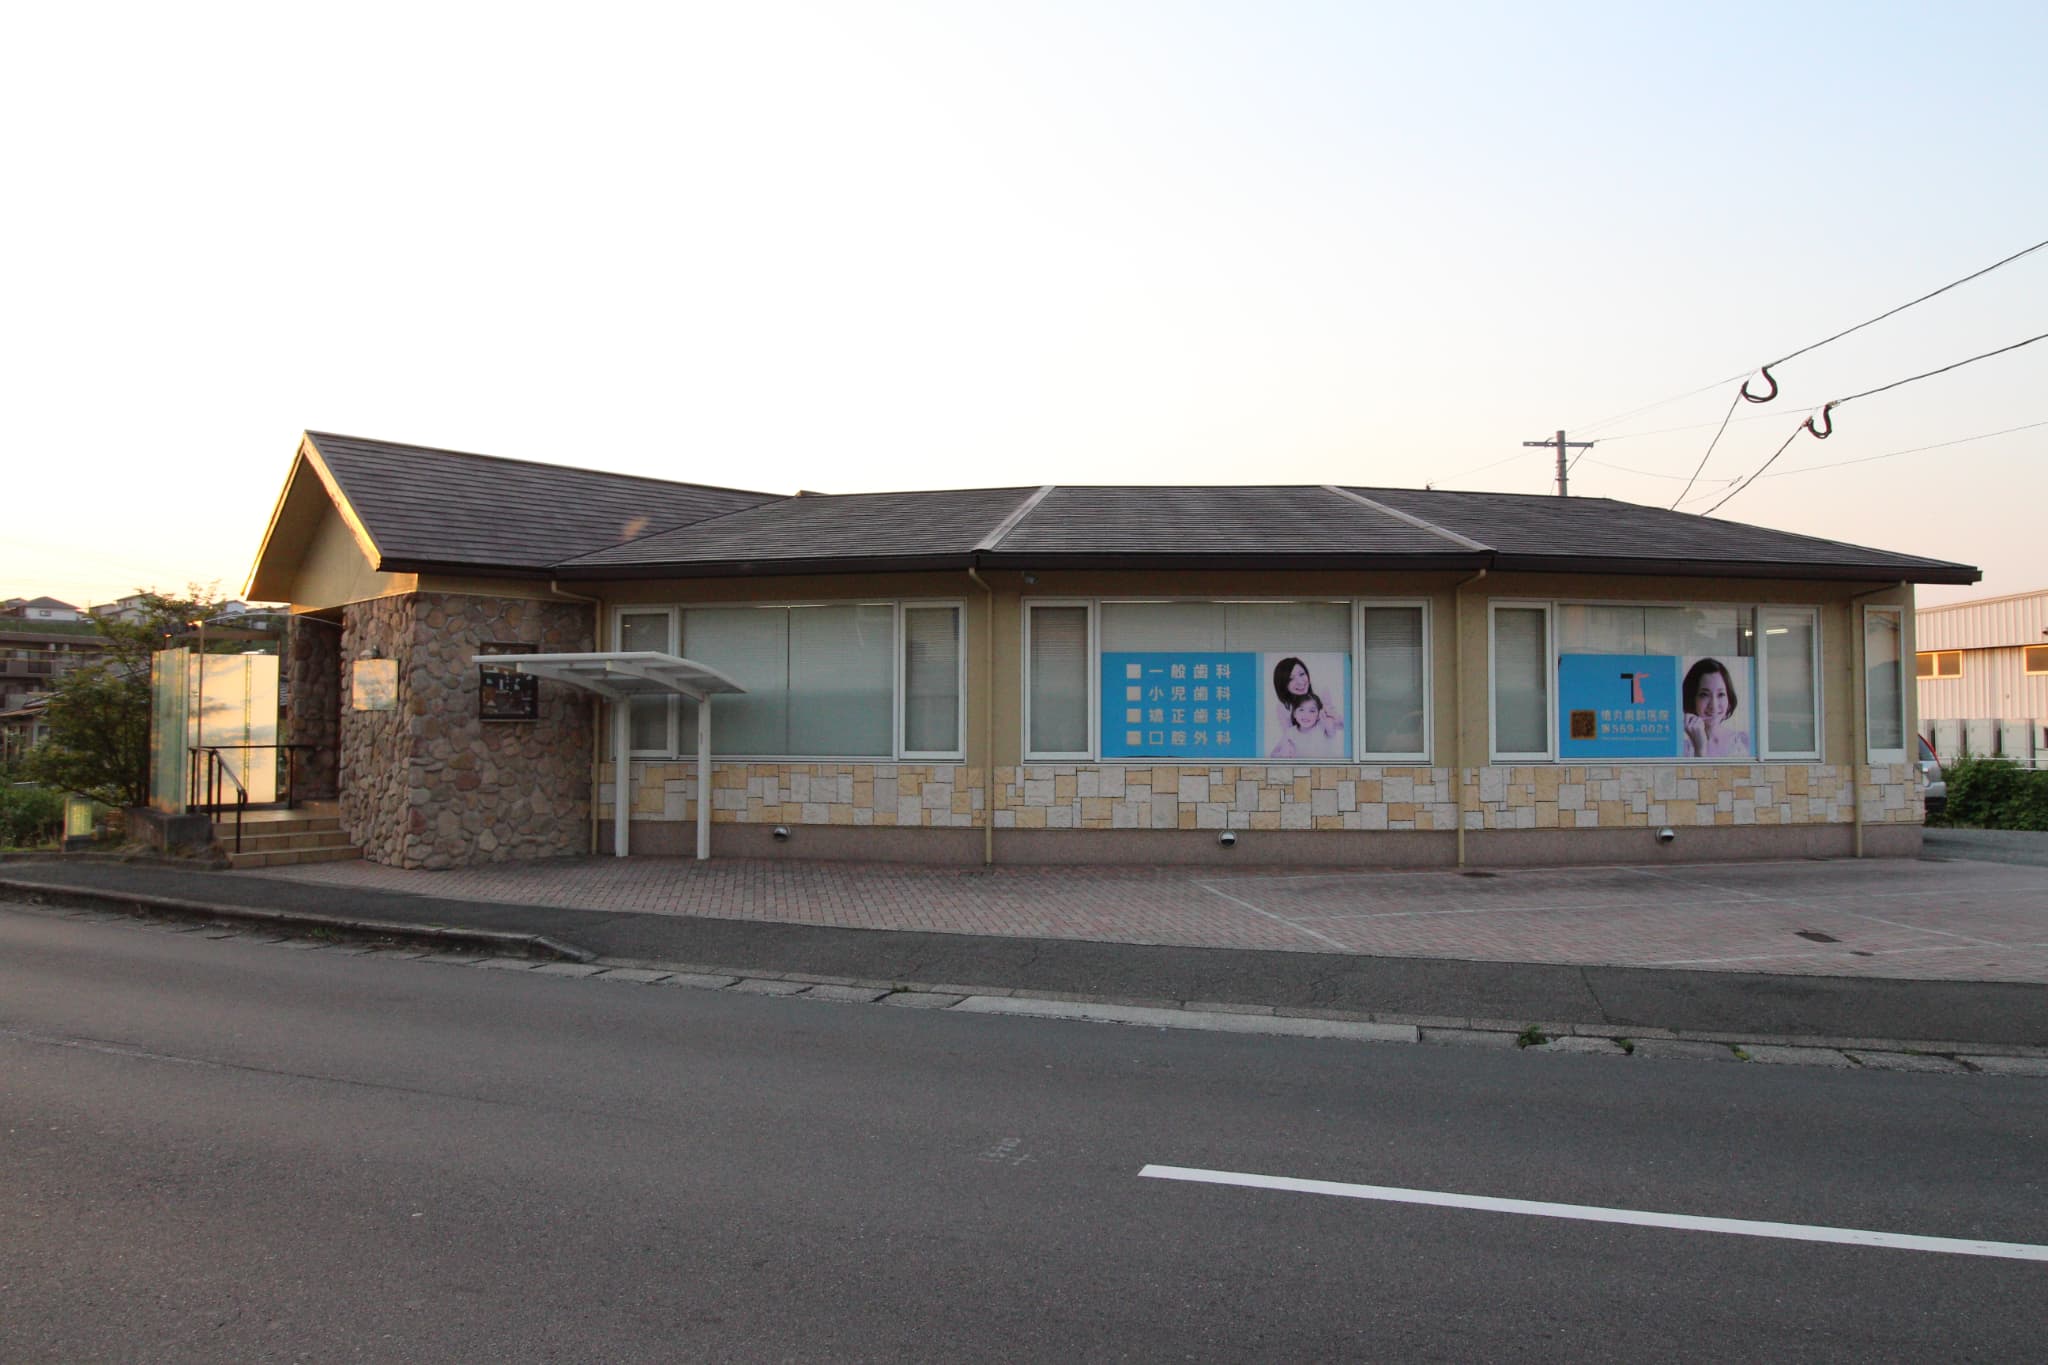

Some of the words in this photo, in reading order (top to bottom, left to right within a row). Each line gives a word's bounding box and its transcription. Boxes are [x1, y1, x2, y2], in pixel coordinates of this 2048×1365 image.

[1149, 664, 1231, 679] 一般歯科
[1149, 686, 1231, 701] 小児歯科
[1149, 708, 1231, 723] 矯正歯科
[1149, 731, 1231, 745] 口腔外科
